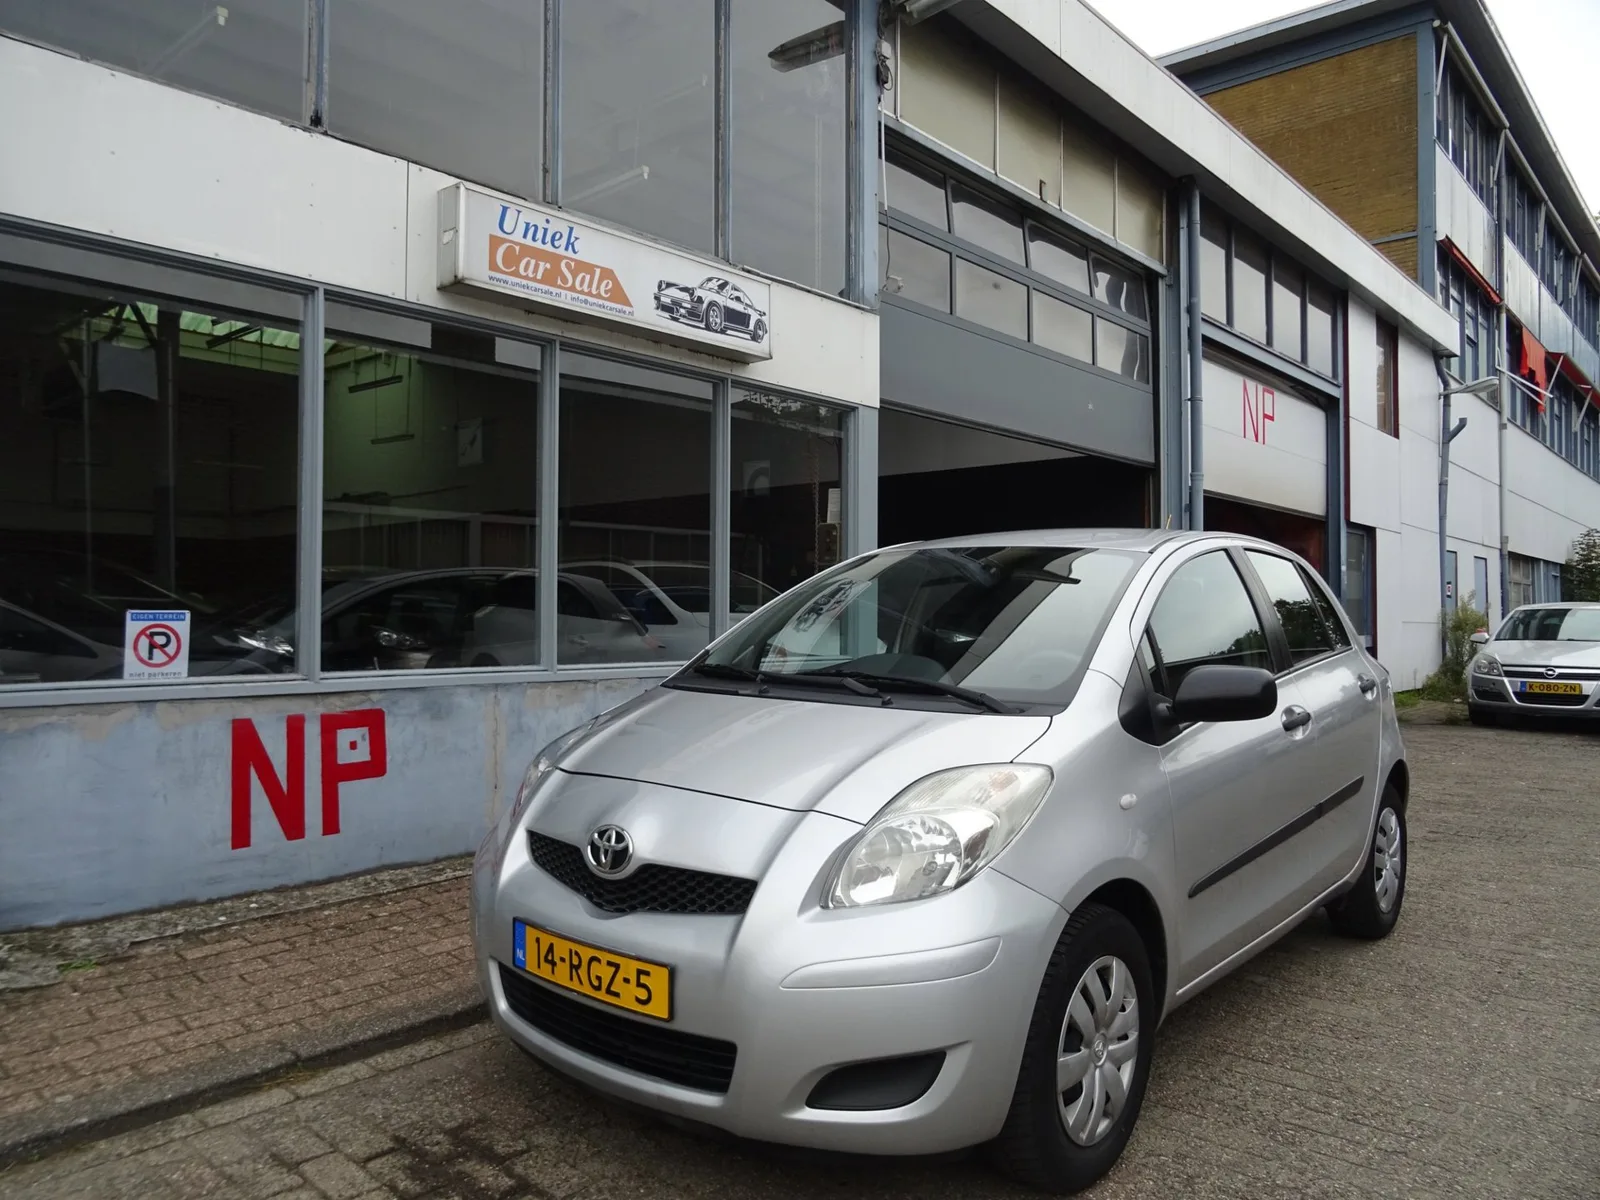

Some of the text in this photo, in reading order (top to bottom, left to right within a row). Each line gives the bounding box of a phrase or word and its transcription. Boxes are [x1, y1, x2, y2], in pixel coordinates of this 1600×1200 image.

[497, 204, 579, 255] Uniek
[488, 274, 635, 317] www.uniekcarsale.nl info@uniekcarsale.nl
[495, 242, 614, 298] Car Sale
[1242, 378, 1275, 445] NP
[148, 671, 182, 679] parkeren
[1528, 683, 1577, 693] K-080-ZN
[231, 708, 387, 850] NP
[516, 948, 525, 961] NL
[535, 936, 652, 1005] 14-RGZ-5
